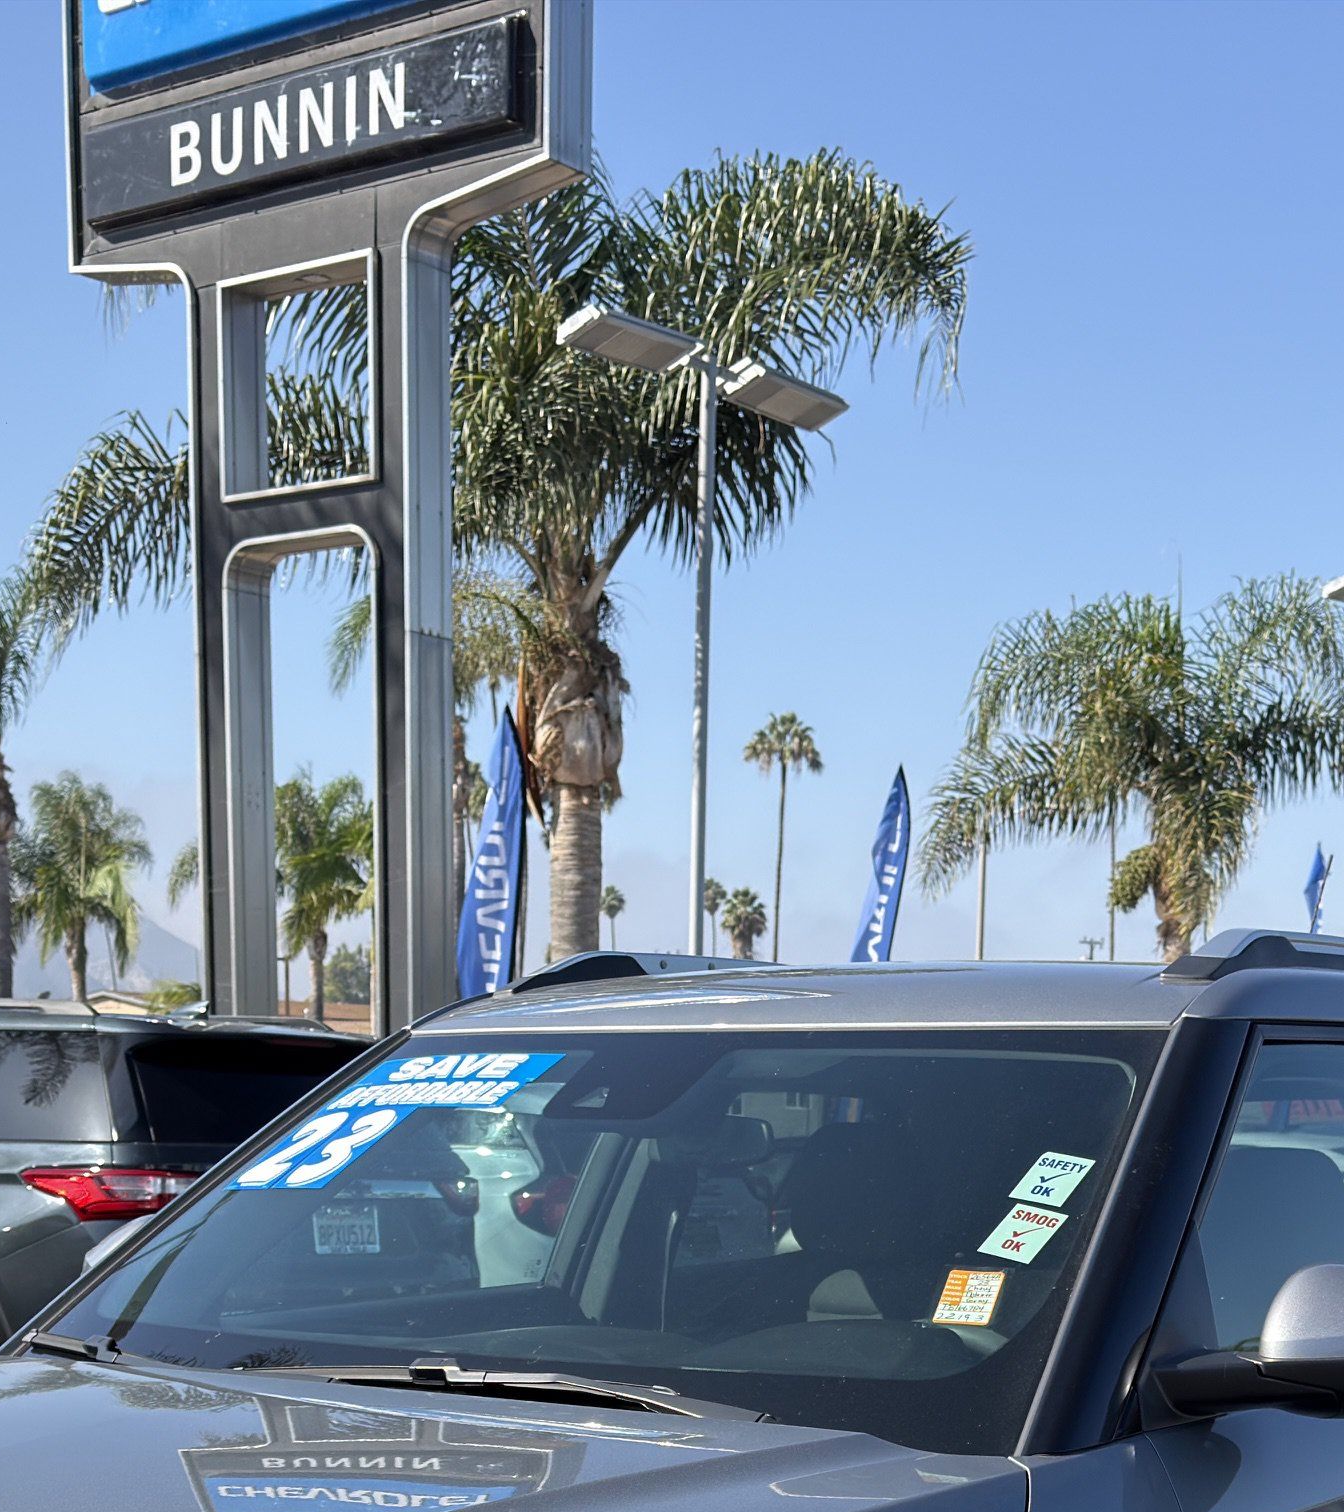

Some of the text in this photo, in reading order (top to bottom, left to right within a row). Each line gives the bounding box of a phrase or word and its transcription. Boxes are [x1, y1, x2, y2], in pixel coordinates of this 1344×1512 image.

[169, 62, 407, 187] BUNNIN
[388, 1053, 530, 1082] SAVE
[326, 1080, 520, 1110] AFFORDABLE
[234, 1107, 399, 1188] 23
[1037, 1157, 1088, 1174] SAFETY
[1030, 1184, 1055, 1198] OK
[1011, 1209, 1060, 1229] SMOG
[1000, 1238, 1026, 1253] OK
